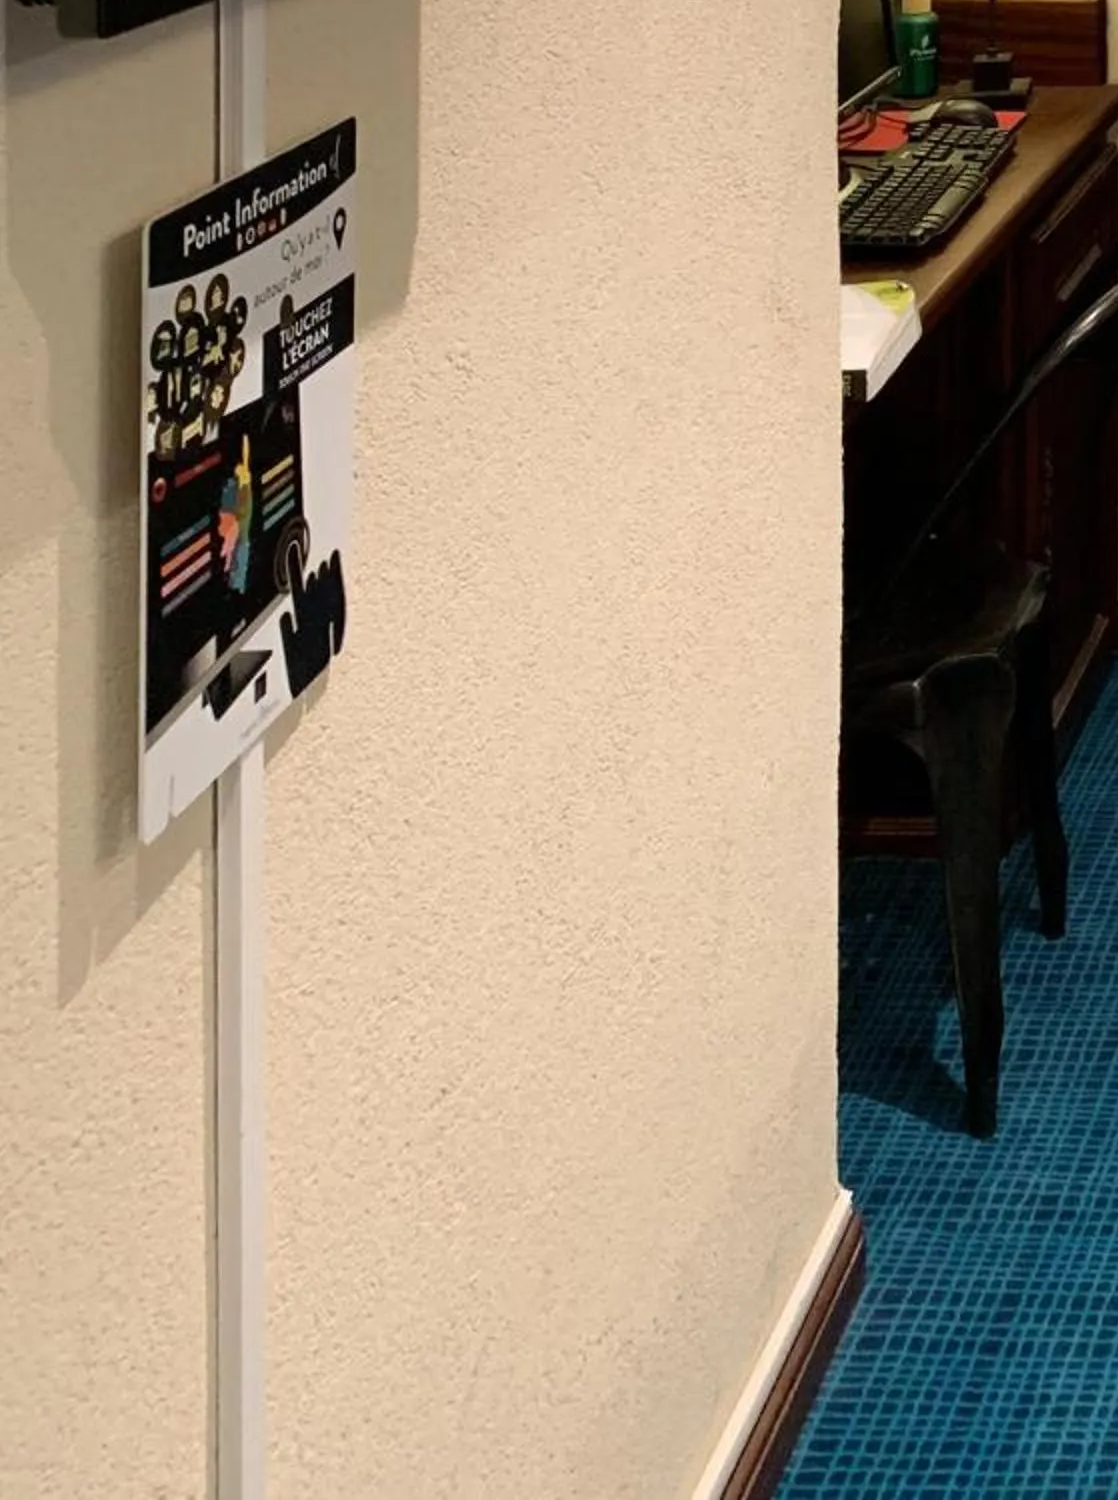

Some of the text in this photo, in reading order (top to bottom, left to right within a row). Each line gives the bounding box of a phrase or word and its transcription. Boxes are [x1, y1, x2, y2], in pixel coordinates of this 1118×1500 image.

[183, 160, 327, 258] Point Information
[278, 297, 334, 349] TOUCHEZ
